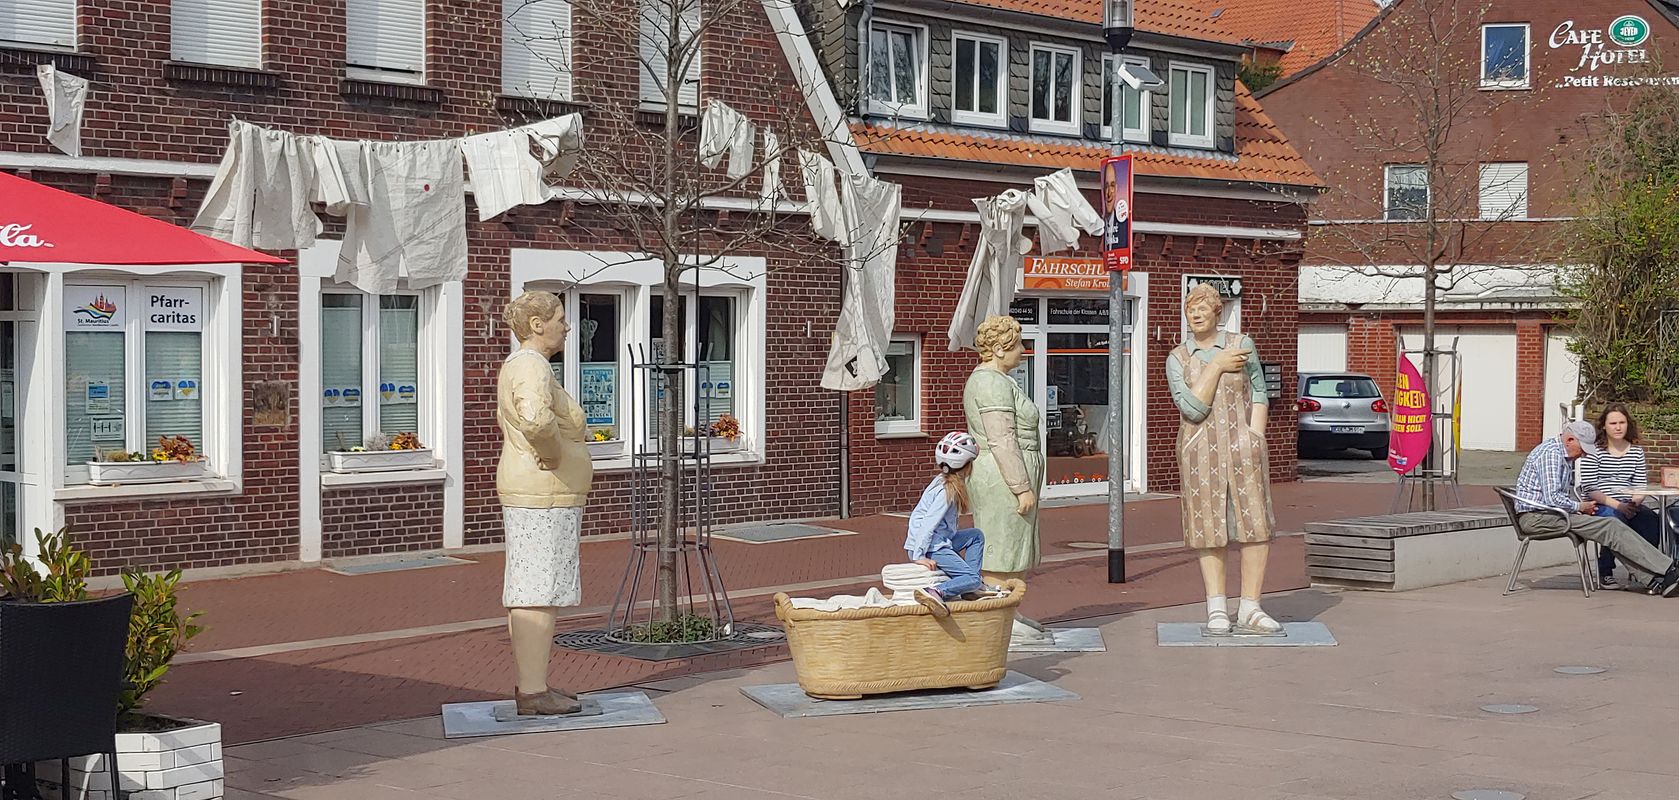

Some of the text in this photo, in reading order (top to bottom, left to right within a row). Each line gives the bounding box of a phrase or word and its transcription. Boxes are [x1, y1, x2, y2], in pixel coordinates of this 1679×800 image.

[1570, 43, 1650, 71] HOTEL
[0, 223, 45, 247] la
[1030, 258, 1110, 275] FAHRSCHU
[1120, 256, 1129, 265] SPD
[1065, 278, 1091, 288] Stefan
[150, 295, 190, 308] Pfarr-
[150, 311, 196, 324] caritas
[1407, 414, 1426, 423] NICHT
